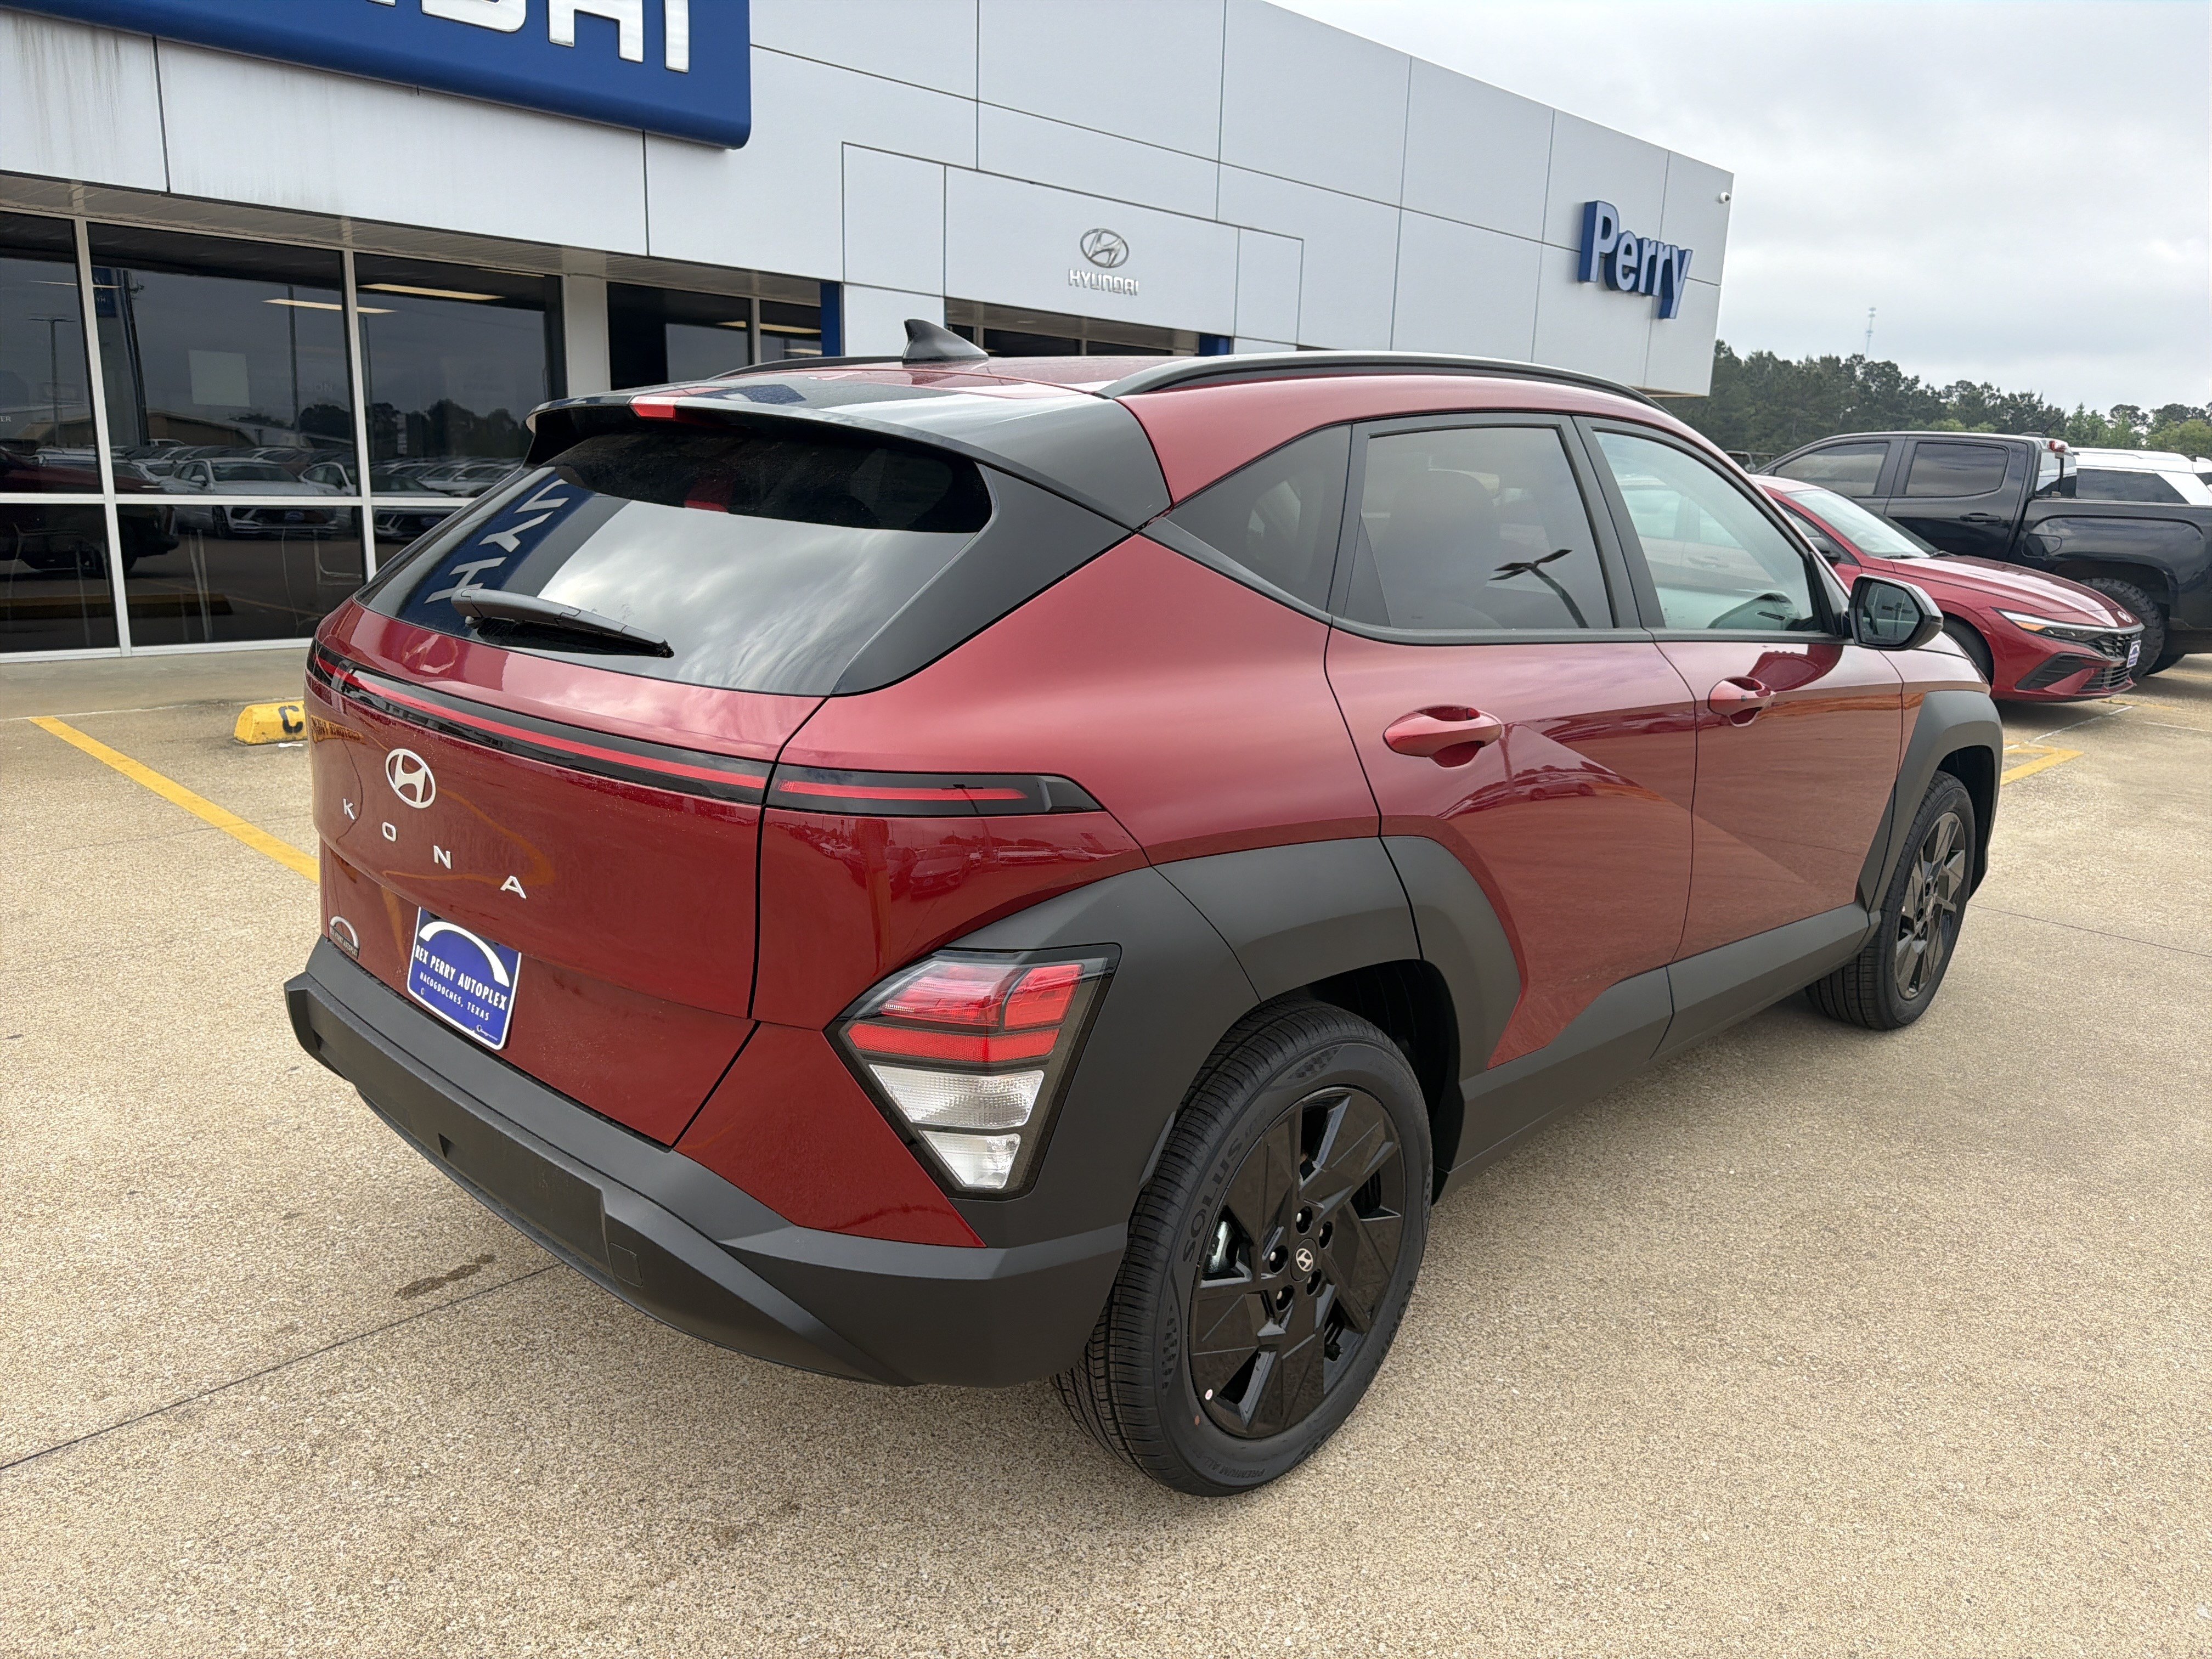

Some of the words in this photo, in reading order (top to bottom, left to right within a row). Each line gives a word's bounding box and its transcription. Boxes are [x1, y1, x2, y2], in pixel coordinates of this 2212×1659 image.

[1068, 269, 1139, 296] HYUNDAI
[1578, 200, 1694, 319] Perry
[342, 798, 527, 899] KONA
[415, 944, 429, 964] REX
[430, 955, 456, 981] PERRY
[458, 973, 507, 1011] AUTOPLEX
[420, 971, 464, 1007] NACOGDOCHES,
[467, 1001, 490, 1021] TEXAS
[1183, 1138, 1243, 1262] SOLUS
